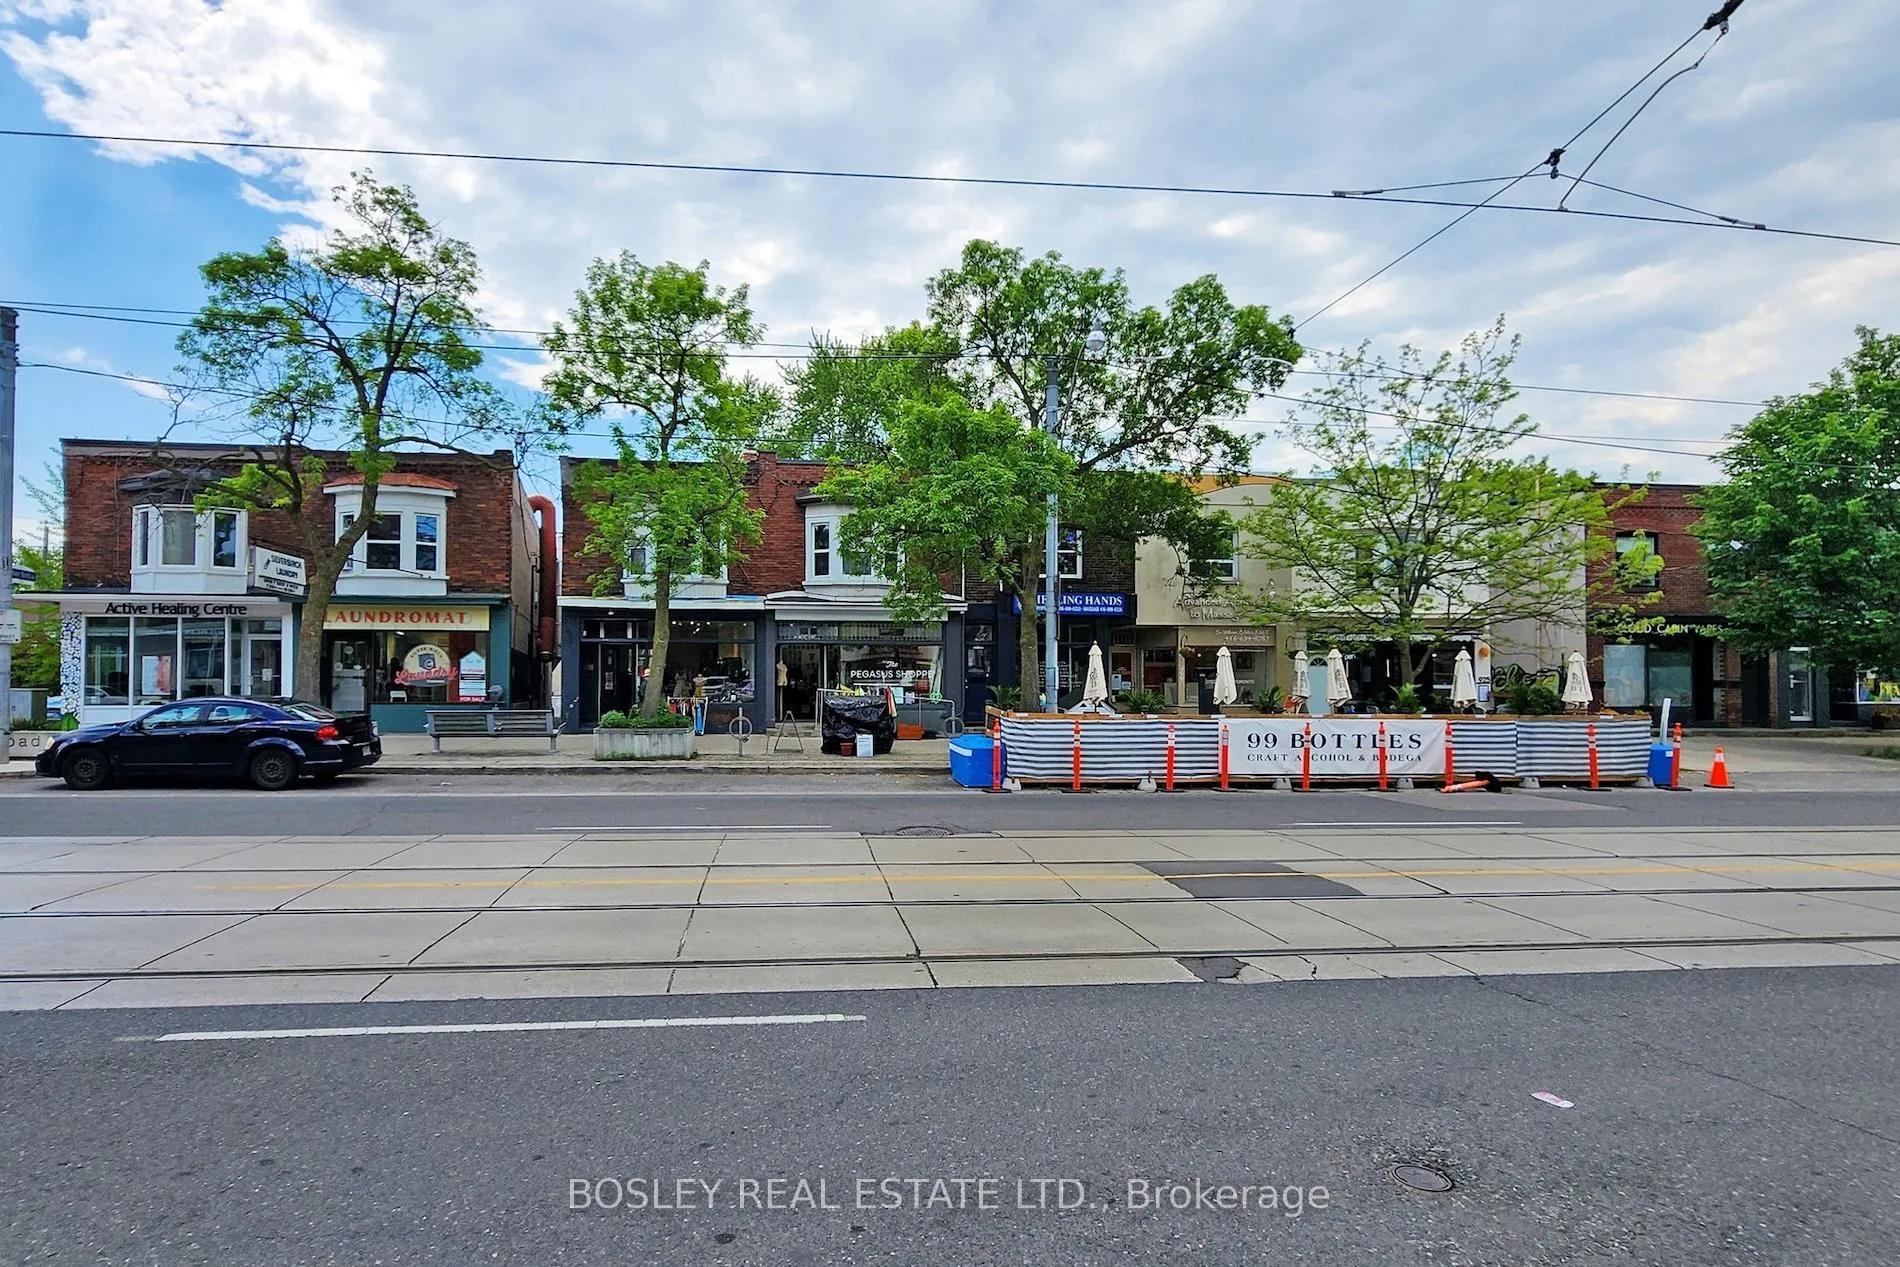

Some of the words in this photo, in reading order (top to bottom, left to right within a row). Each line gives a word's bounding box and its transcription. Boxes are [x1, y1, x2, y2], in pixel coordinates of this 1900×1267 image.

[1084, 595, 1123, 606] HANDS
[105, 602, 148, 615] Active
[151, 603, 200, 617] Healing
[203, 604, 248, 615] Centre
[1190, 609, 1200, 618] to
[882, 660, 898, 669] The
[394, 667, 458, 685] Laundry
[850, 670, 894, 679] PEGASUS
[895, 670, 935, 679] SHOPPE
[1247, 733, 1278, 749] 99
[1291, 733, 1422, 749] BOTTLES
[1247, 754, 1288, 762] CRAFT
[1294, 754, 1351, 762] ACOHOL
[1358, 754, 1366, 762] &
[1372, 754, 1422, 762] BDEGA
